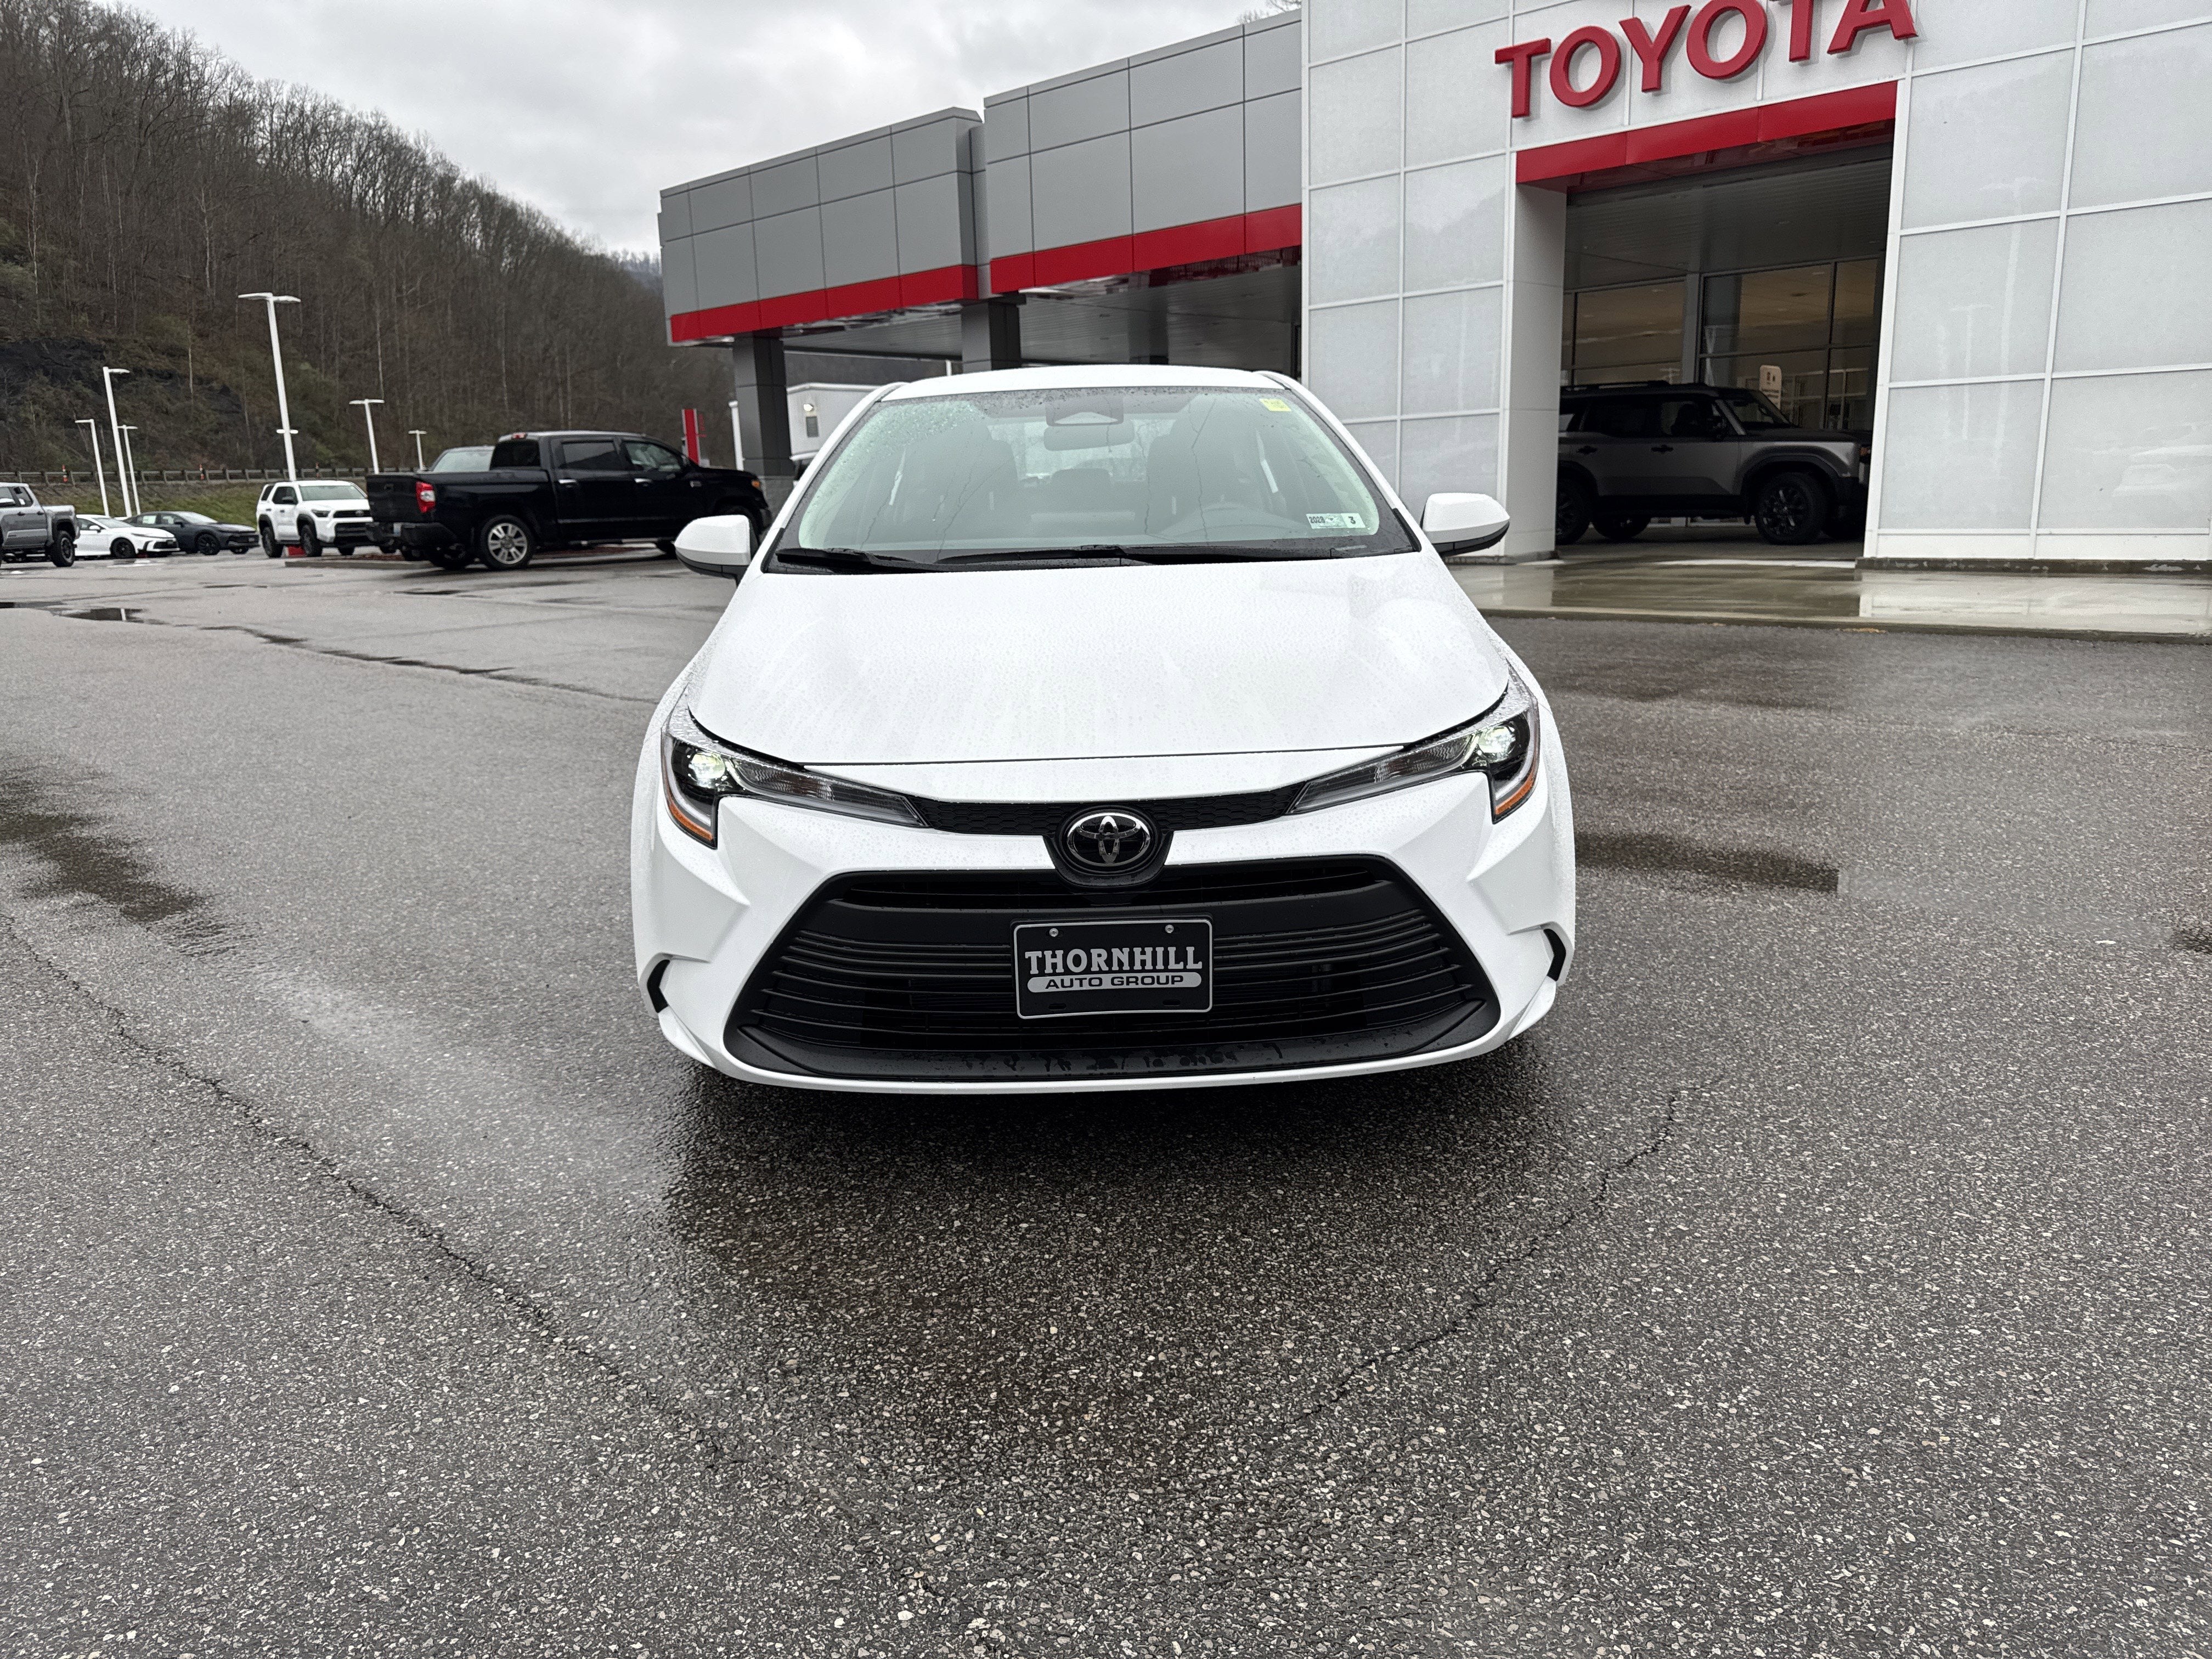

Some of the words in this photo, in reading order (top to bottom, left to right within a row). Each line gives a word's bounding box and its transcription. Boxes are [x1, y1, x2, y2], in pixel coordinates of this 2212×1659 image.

[1495, 0, 1918, 118] TOYOTA
[1348, 516, 1356, 524] 3
[1025, 946, 1203, 974] THORNHILL
[1045, 977, 1103, 989] AUTO
[1110, 975, 1184, 986] GROUP
